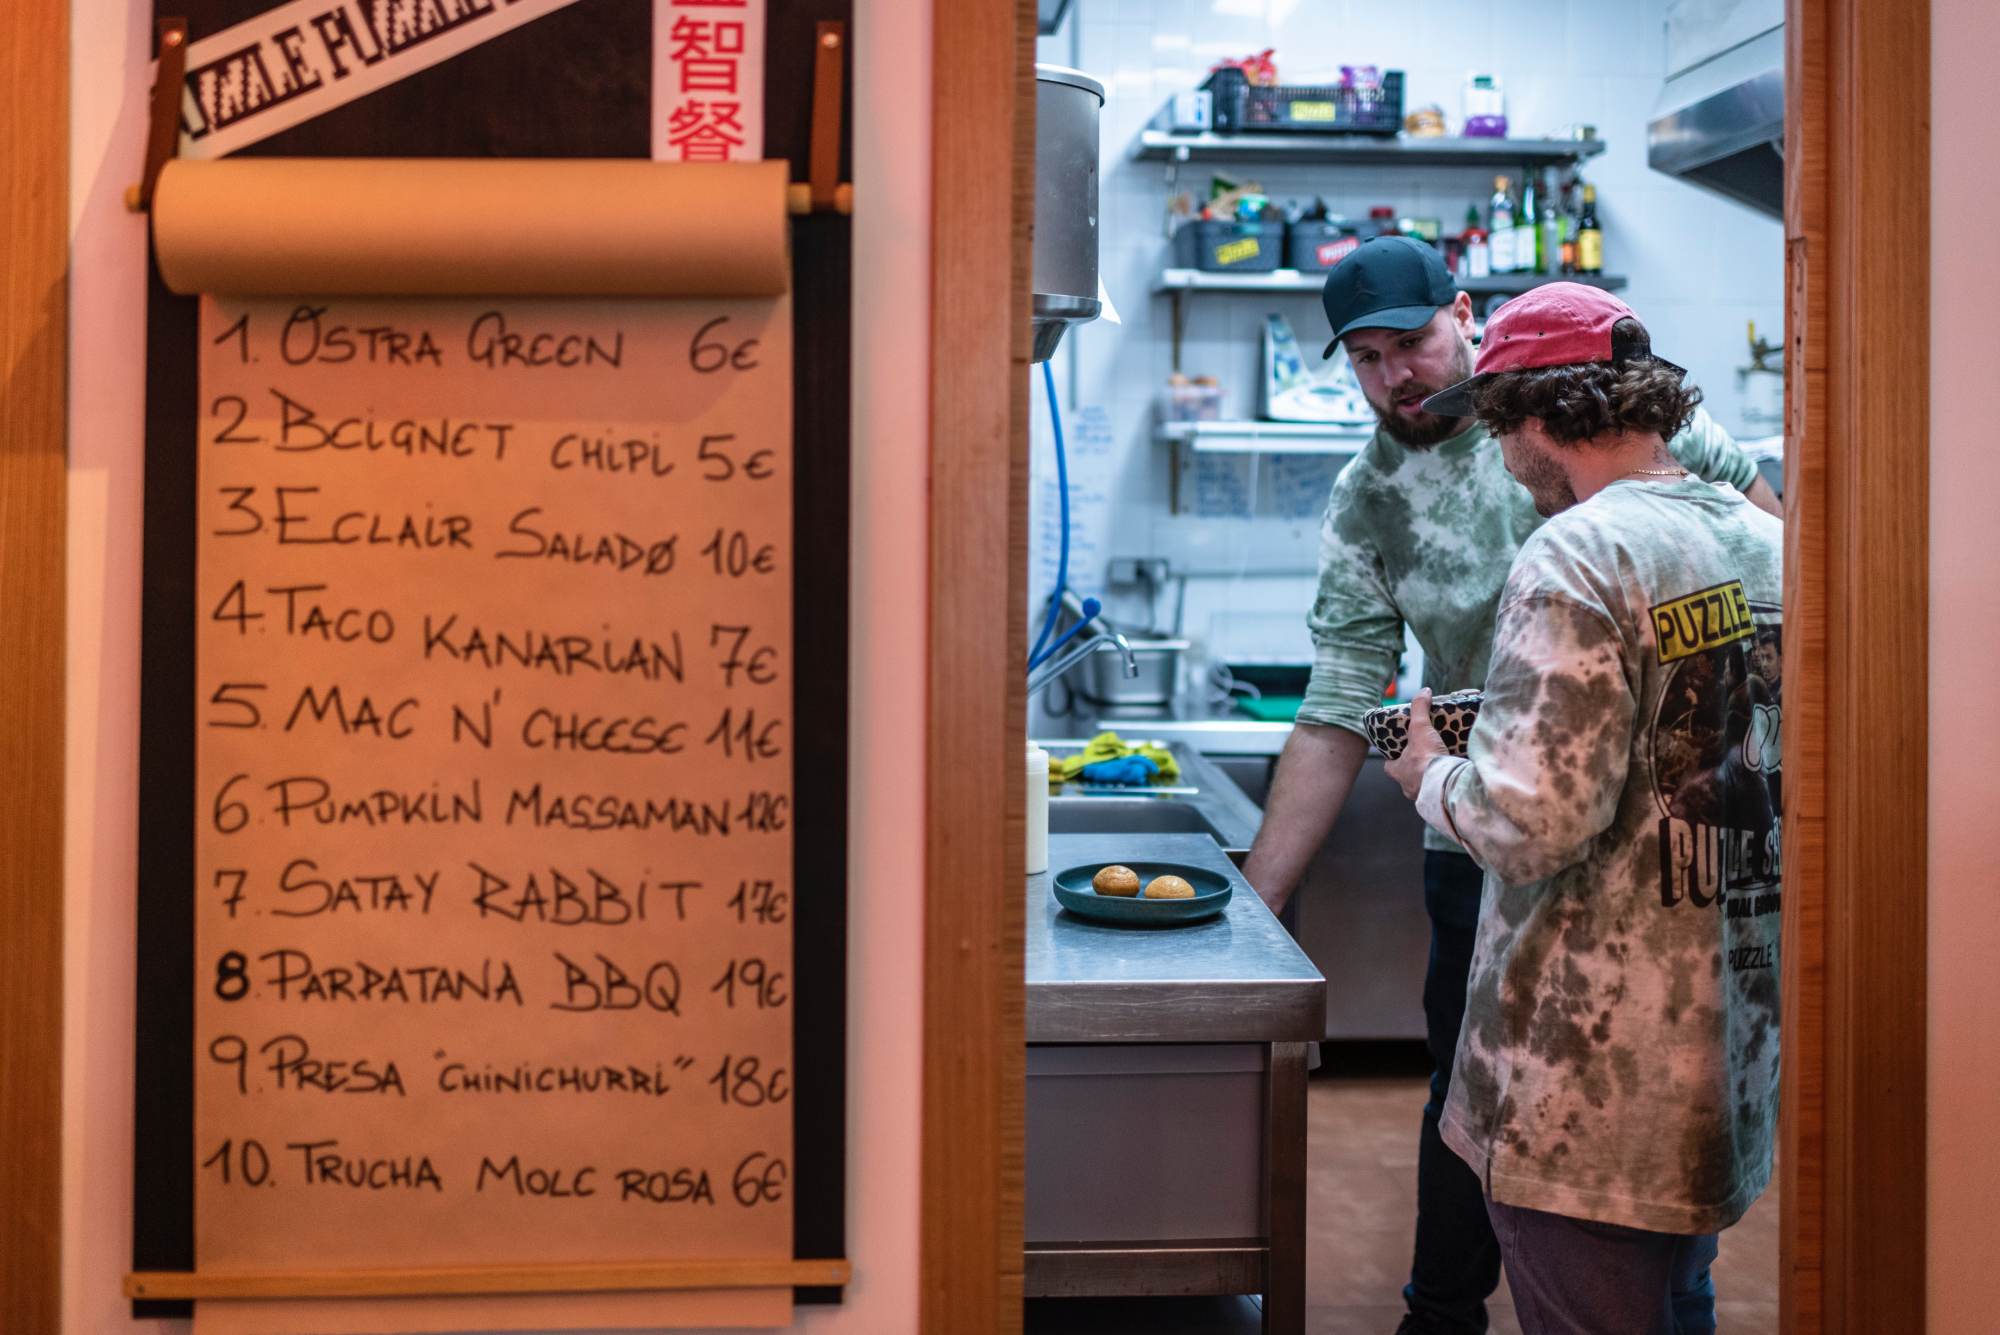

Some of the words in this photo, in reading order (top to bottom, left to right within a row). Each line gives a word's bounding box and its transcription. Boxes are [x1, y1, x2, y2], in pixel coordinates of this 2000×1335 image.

[668, 0, 747, 161] 智餐
[467, 310, 624, 369] GREEN
[688, 315, 759, 374] 6€
[696, 433, 775, 482] 5€
[701, 527, 776, 578] 10€
[265, 582, 395, 645] TACO
[709, 622, 778, 687] 7€
[1657, 588, 1752, 656] PUZZLE
[283, 684, 420, 741] MAC
[521, 707, 688, 756] CHEESE
[705, 707, 783, 762] 11€
[505, 782, 731, 836] MASSAMAN
[270, 858, 441, 919] SATAY
[726, 880, 788, 924] 17€
[259, 948, 525, 1007] PARPATANA
[548, 951, 682, 1018] BBQ
[710, 957, 788, 1009] 19€
[1728, 943, 1773, 972] PUZZLE
[260, 1033, 407, 1098] PRESA
[709, 1054, 789, 1107] 18€
[203, 1139, 276, 1189] 10.
[286, 1139, 443, 1193] TRUCHA
[475, 1155, 598, 1199] MOLE
[614, 1167, 716, 1206] ROSA
[731, 1151, 788, 1208] 6€
